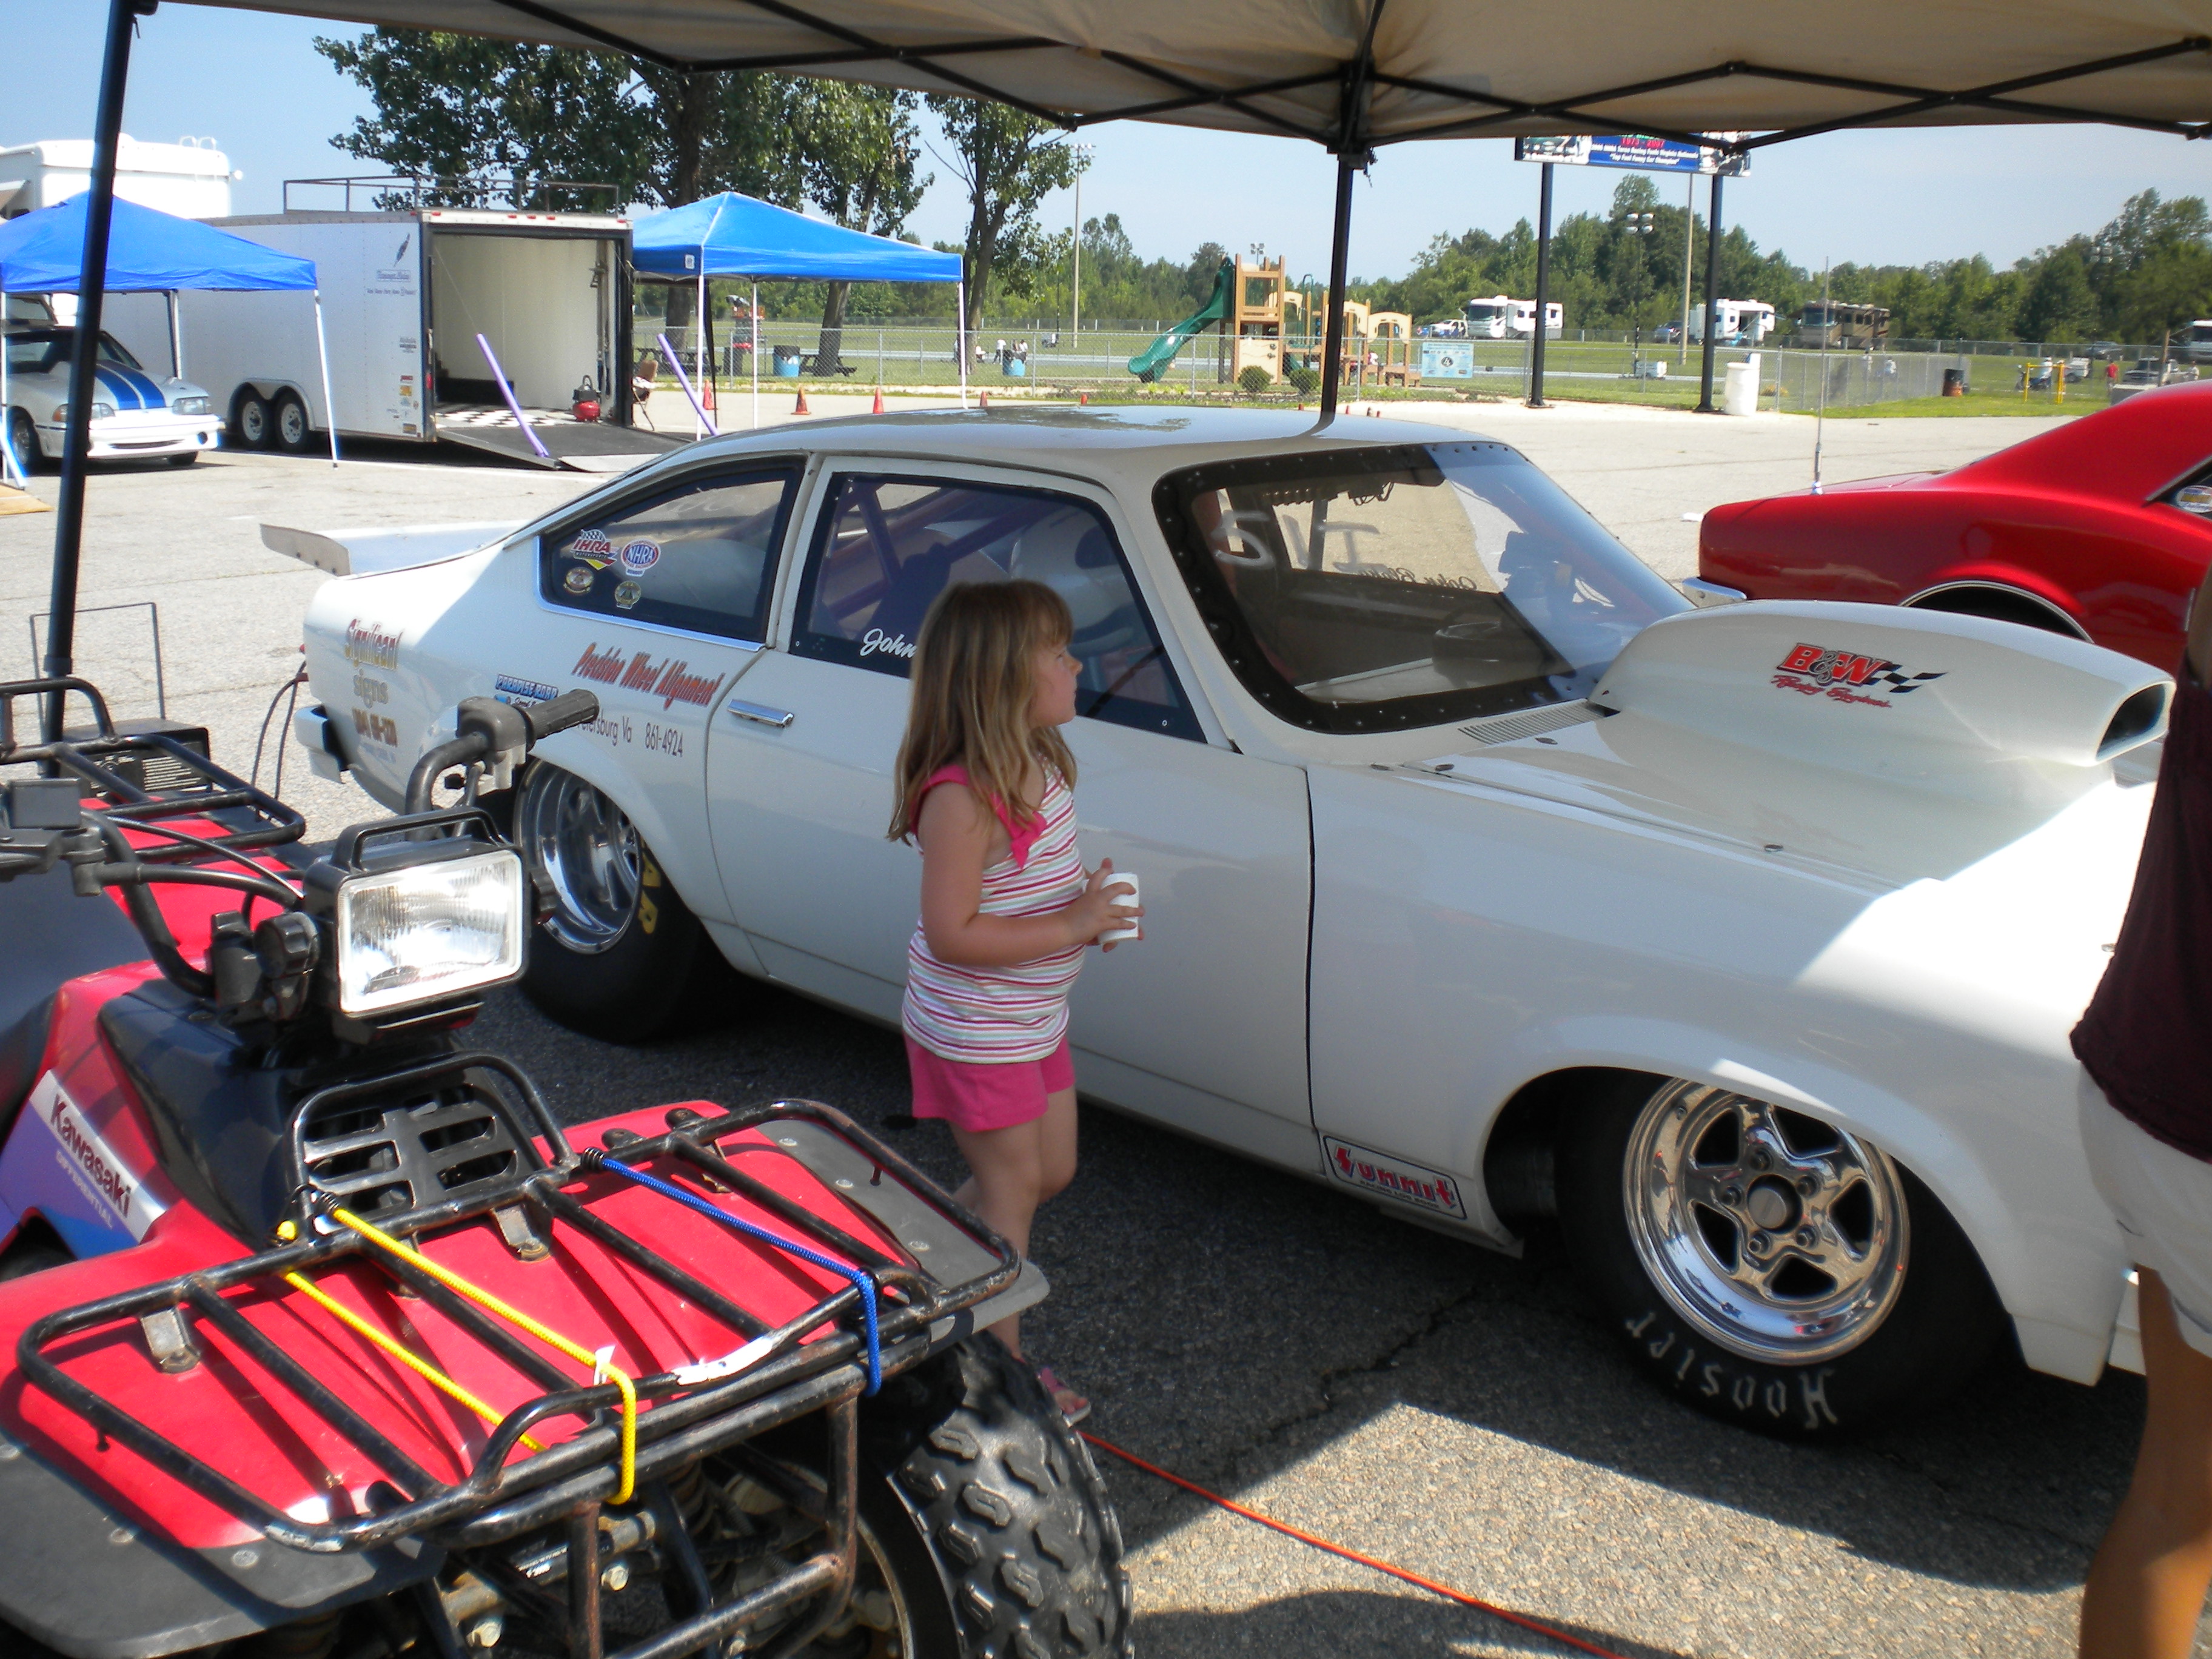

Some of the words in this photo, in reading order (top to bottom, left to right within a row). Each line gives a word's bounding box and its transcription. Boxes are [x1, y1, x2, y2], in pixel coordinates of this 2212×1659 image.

[572, 538, 611, 554] IHRA
[626, 545, 654, 564] NHRA
[344, 618, 405, 672] Significant
[1777, 642, 1893, 688] B&W
[352, 668, 389, 709] signs
[571, 641, 627, 685] Precision
[618, 651, 670, 694] Wheel
[652, 659, 726, 711] Alignment
[645, 722, 683, 757] 861-4924
[50, 1093, 132, 1219] Kawasaki
[1335, 1147, 1457, 1209] Summit
[1623, 1310, 1839, 1430] Hoosier
